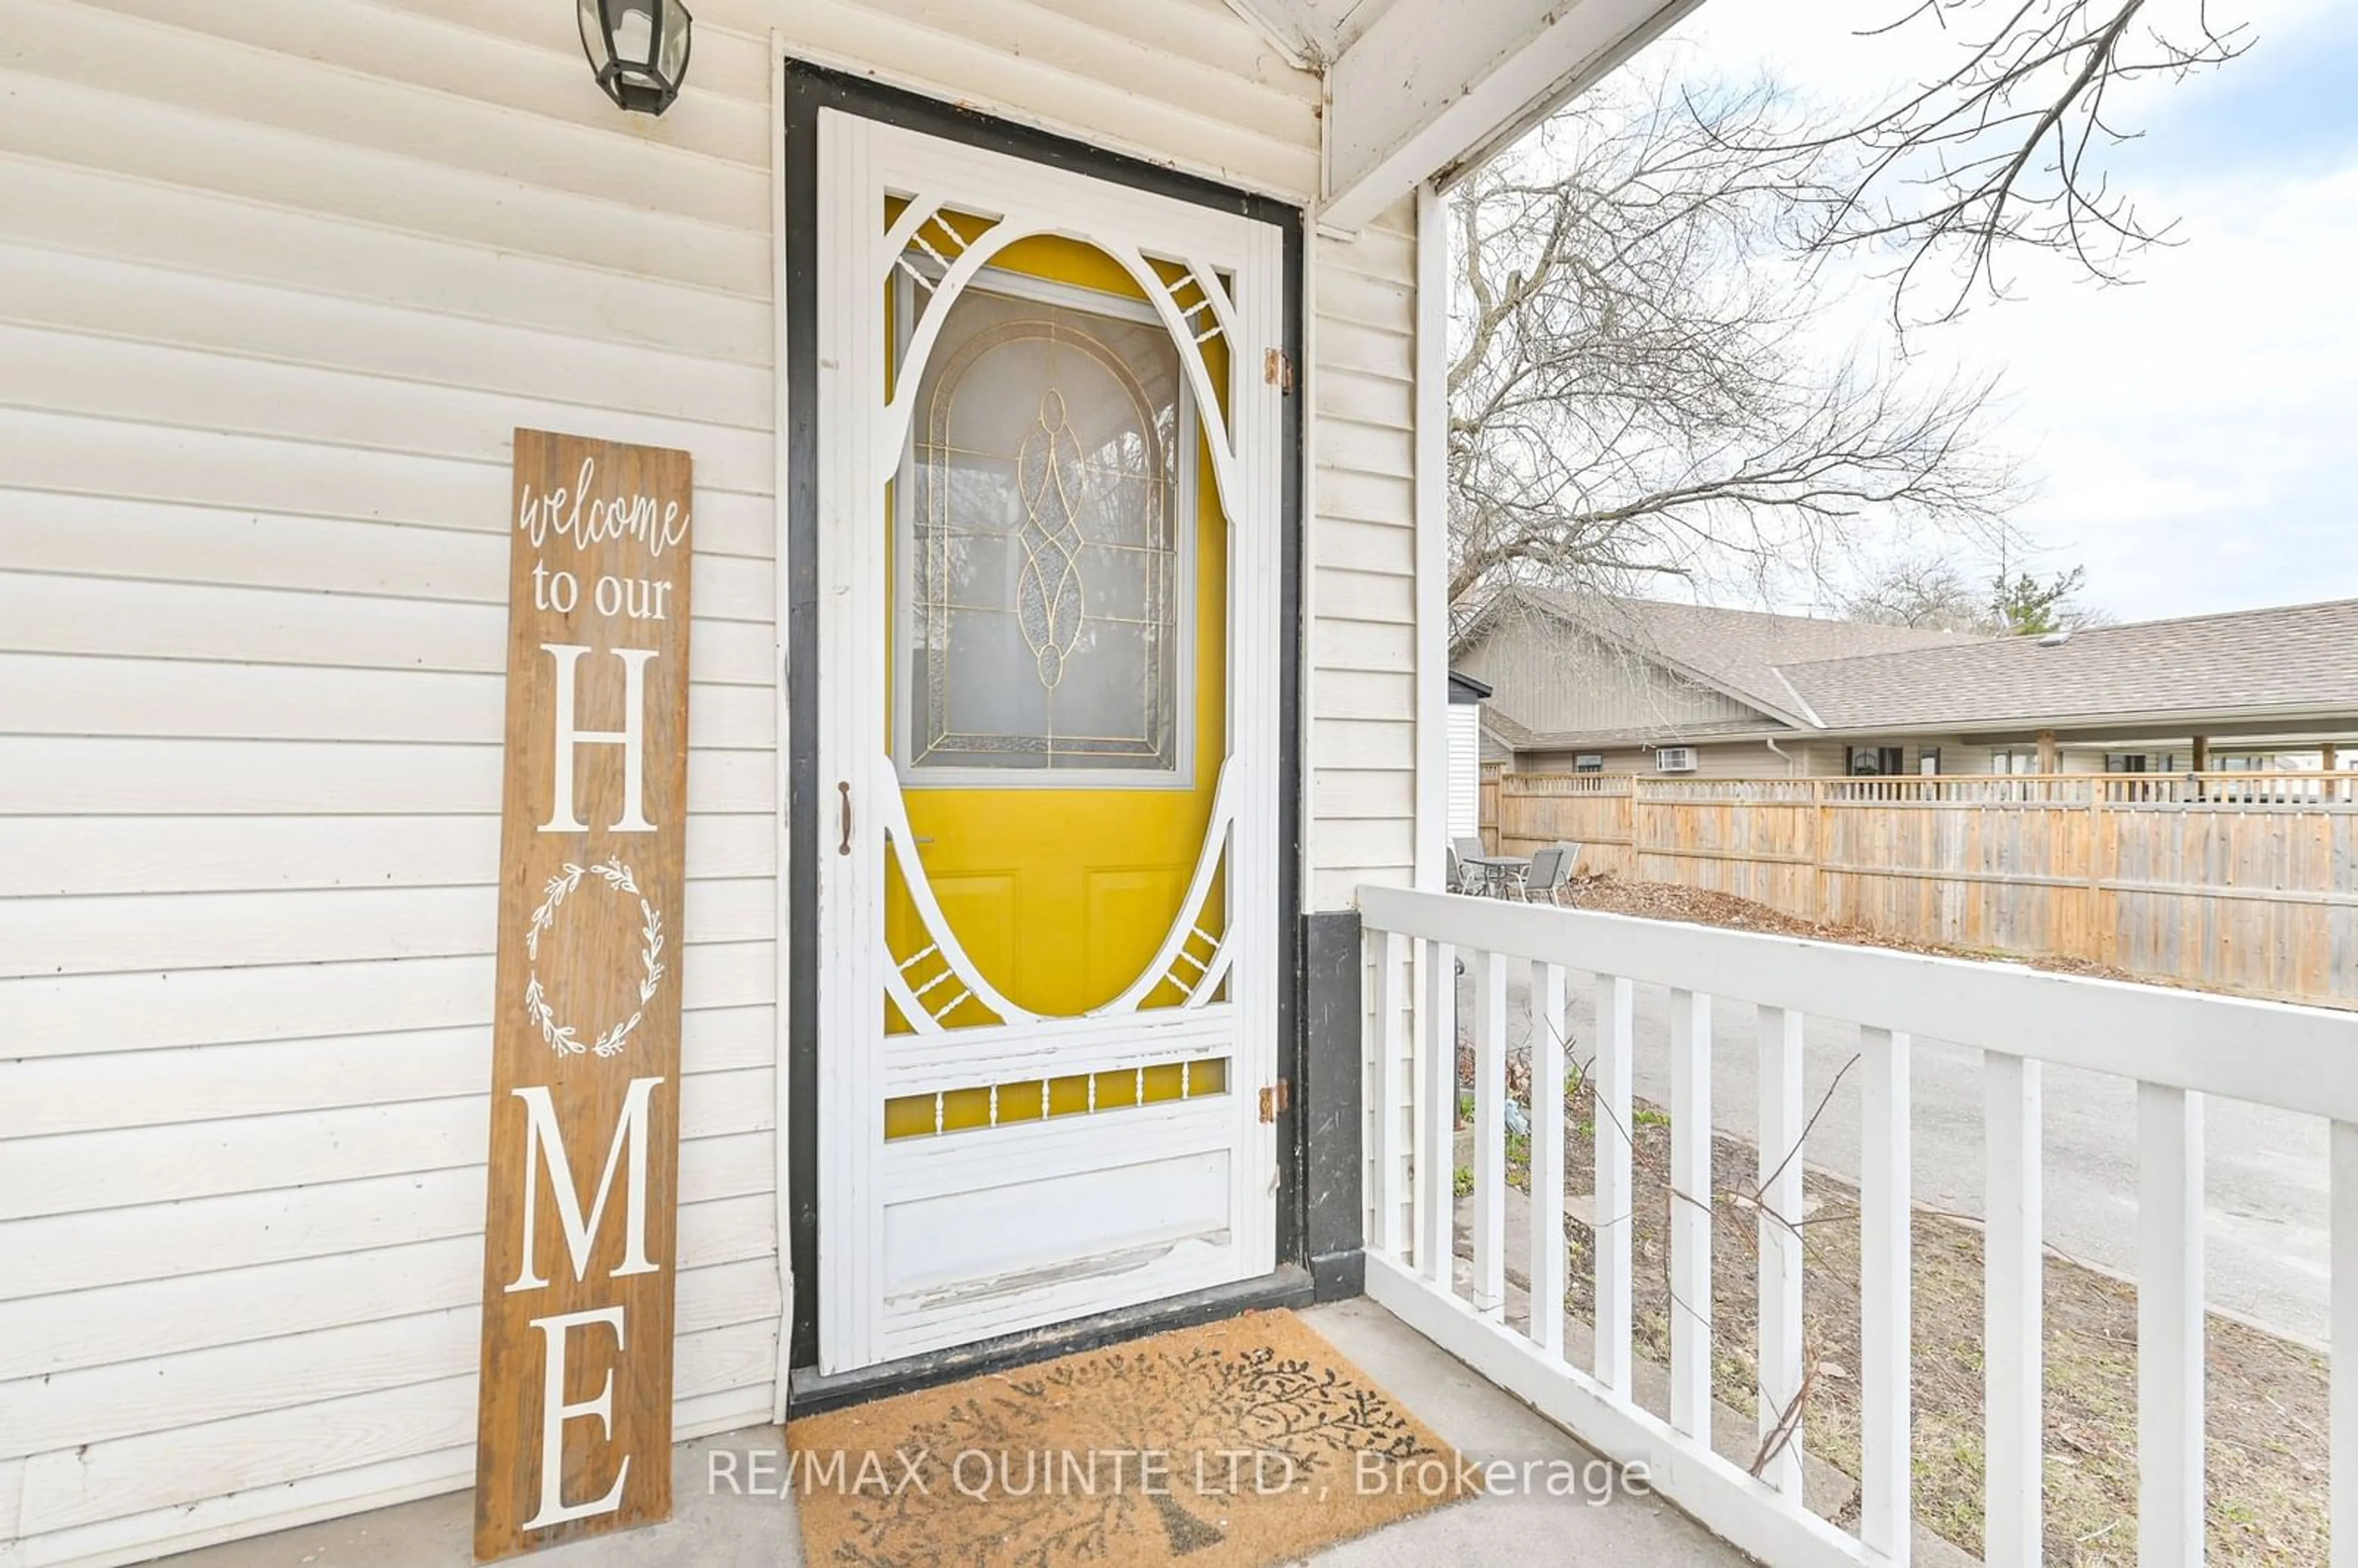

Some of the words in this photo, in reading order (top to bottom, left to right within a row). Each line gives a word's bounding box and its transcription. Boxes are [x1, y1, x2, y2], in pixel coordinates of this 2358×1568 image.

[519, 457, 690, 557] welcome
[532, 558, 578, 613] to
[594, 574, 673, 620] our
